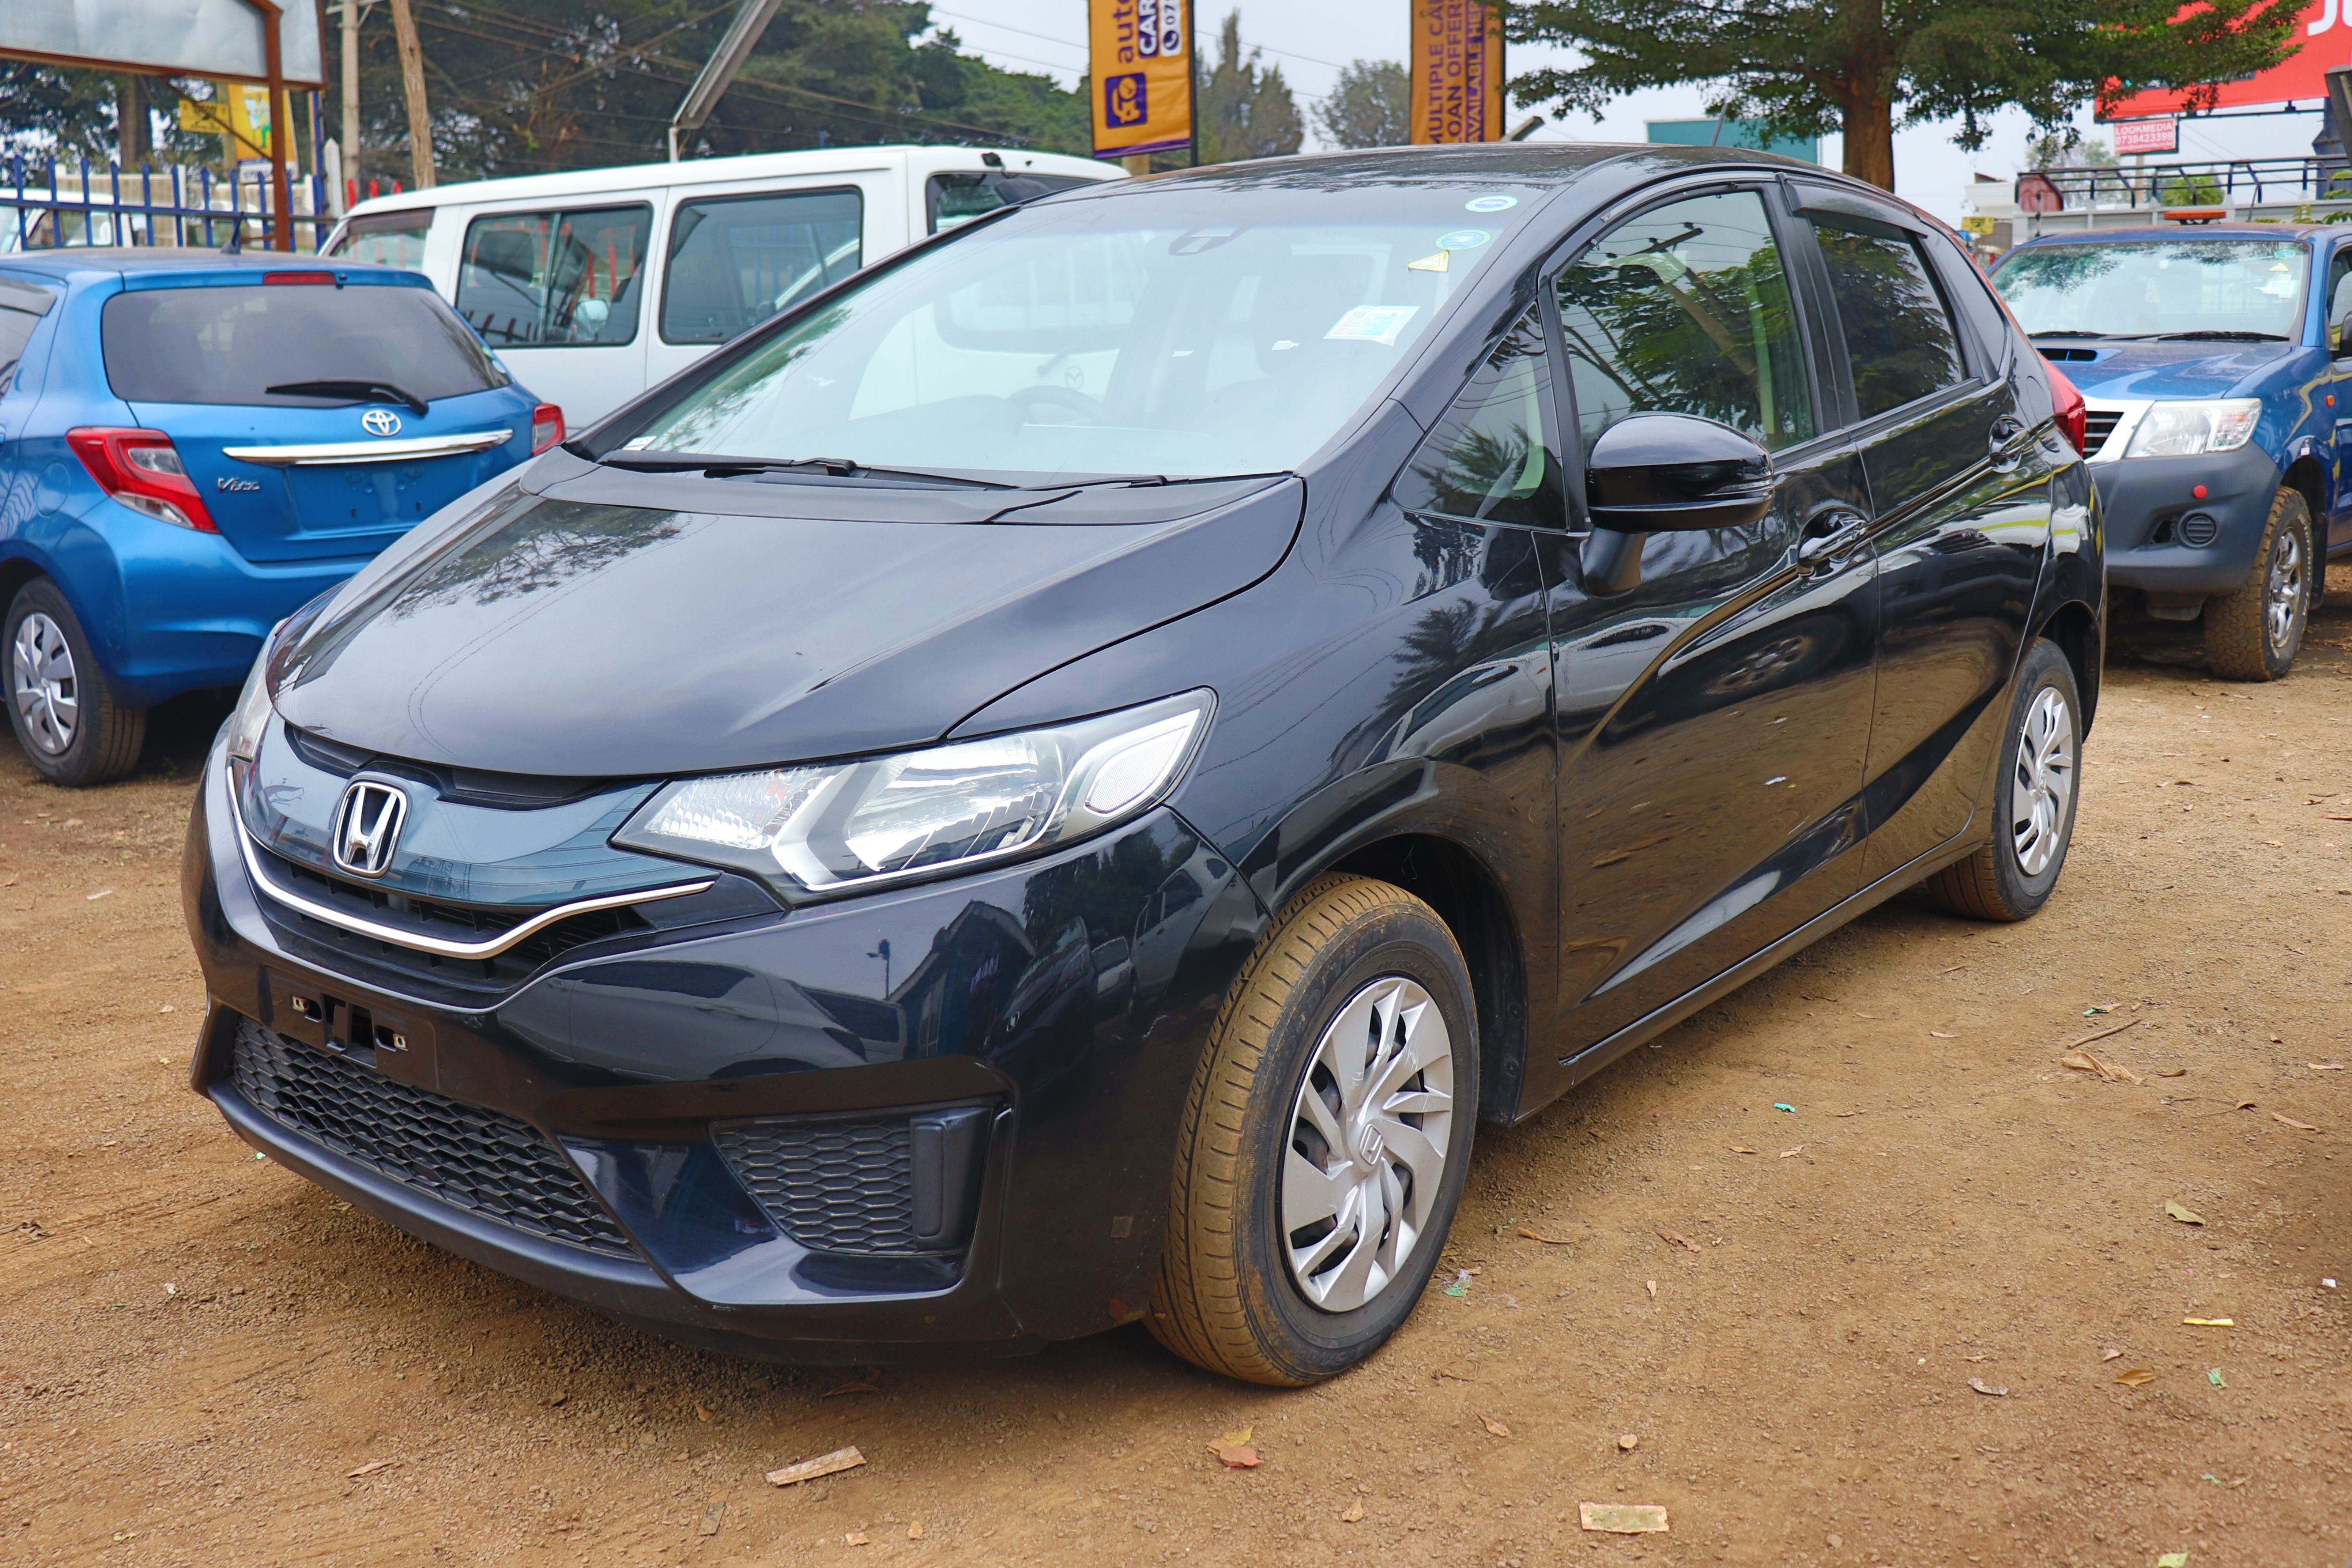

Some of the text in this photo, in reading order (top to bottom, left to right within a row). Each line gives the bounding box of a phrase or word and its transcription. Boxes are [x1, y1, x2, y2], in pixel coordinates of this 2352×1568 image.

[1113, 0, 1134, 64] aut
[1429, 0, 1444, 36] CA
[1447, 0, 1462, 143] OAN OFFER
[2116, 122, 2172, 136] LOOKMEDIA
